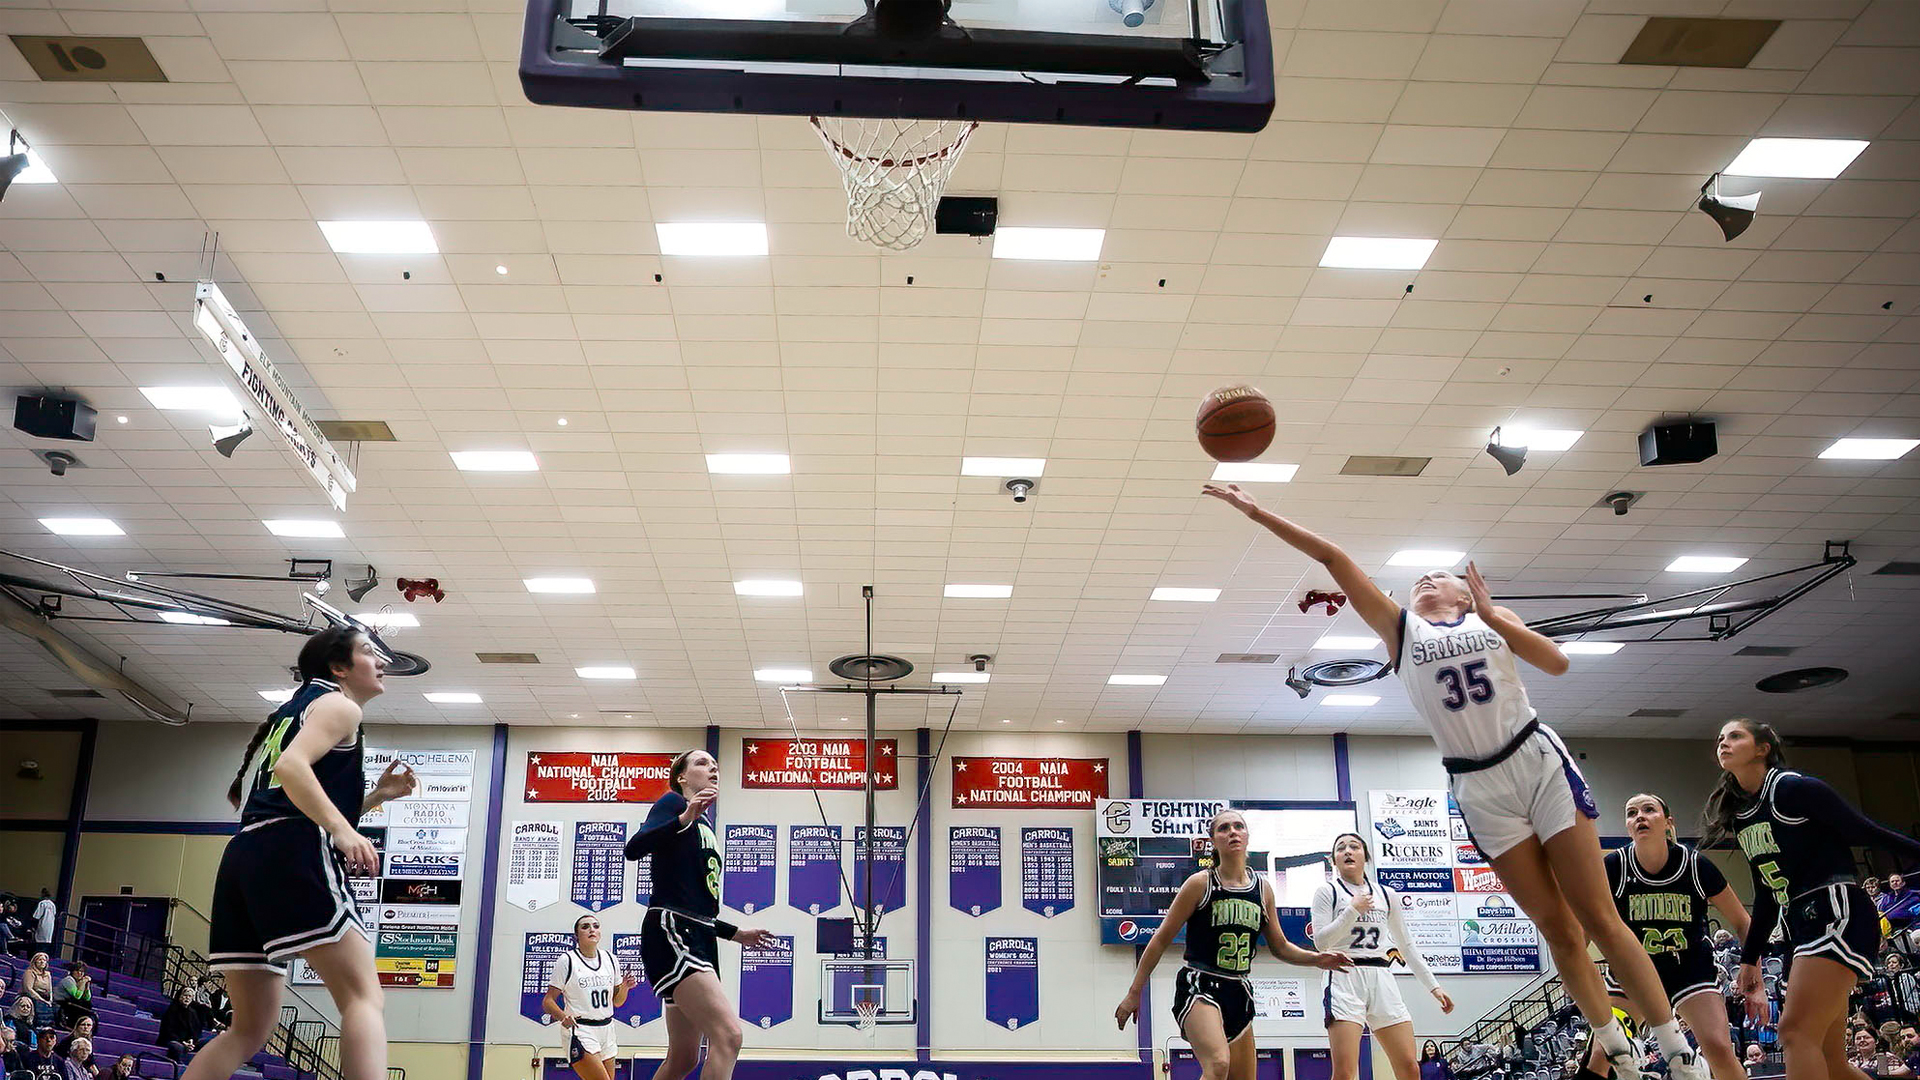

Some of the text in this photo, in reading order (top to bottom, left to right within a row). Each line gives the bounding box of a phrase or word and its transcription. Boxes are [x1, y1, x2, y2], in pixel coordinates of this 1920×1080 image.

[242, 361, 284, 421] FIGHTING
[260, 352, 324, 444] ELK MOUNTAIN MOTORS
[1411, 629, 1501, 666] SAINTS
[1435, 658, 1495, 713] 35
[788, 743, 850, 755] 2003 NAIA
[428, 754, 469, 763] HELENA
[591, 755, 619, 766] NAIA
[786, 757, 852, 769] FOOTBALL
[538, 766, 671, 779] NATIONAL CHAMPIONS
[992, 762, 1068, 774] 2004 NAIA
[759, 771, 816, 783] NATIONAL
[999, 776, 1062, 788] FOOTBALL
[571, 778, 635, 790] FOOTBALL
[588, 790, 617, 800] 2002
[970, 790, 1091, 803] NATIONAL CHAMPION
[1394, 796, 1437, 810] Eagle
[1142, 802, 1224, 817] FIGHTING
[515, 823, 559, 835] CARROLL
[579, 823, 623, 835] CARROLL
[729, 827, 773, 839] CARROLL
[794, 828, 838, 840] CARROLL
[953, 828, 997, 839] CARROLL
[1026, 830, 1069, 842] CARROLL
[1382, 843, 1443, 857] RUCKERS
[390, 855, 459, 864] CLARK'S
[1629, 893, 1692, 922] PROVIDENCE
[1212, 898, 1261, 931] PROVIDENCE
[1481, 923, 1533, 935] Miller's
[395, 933, 454, 944] Stockman Bank
[529, 934, 574, 945] CARROLL
[1349, 926, 1380, 949] 23
[990, 939, 1034, 951] CARROLL
[1217, 933, 1250, 970] 22
[591, 989, 608, 1008] 00
